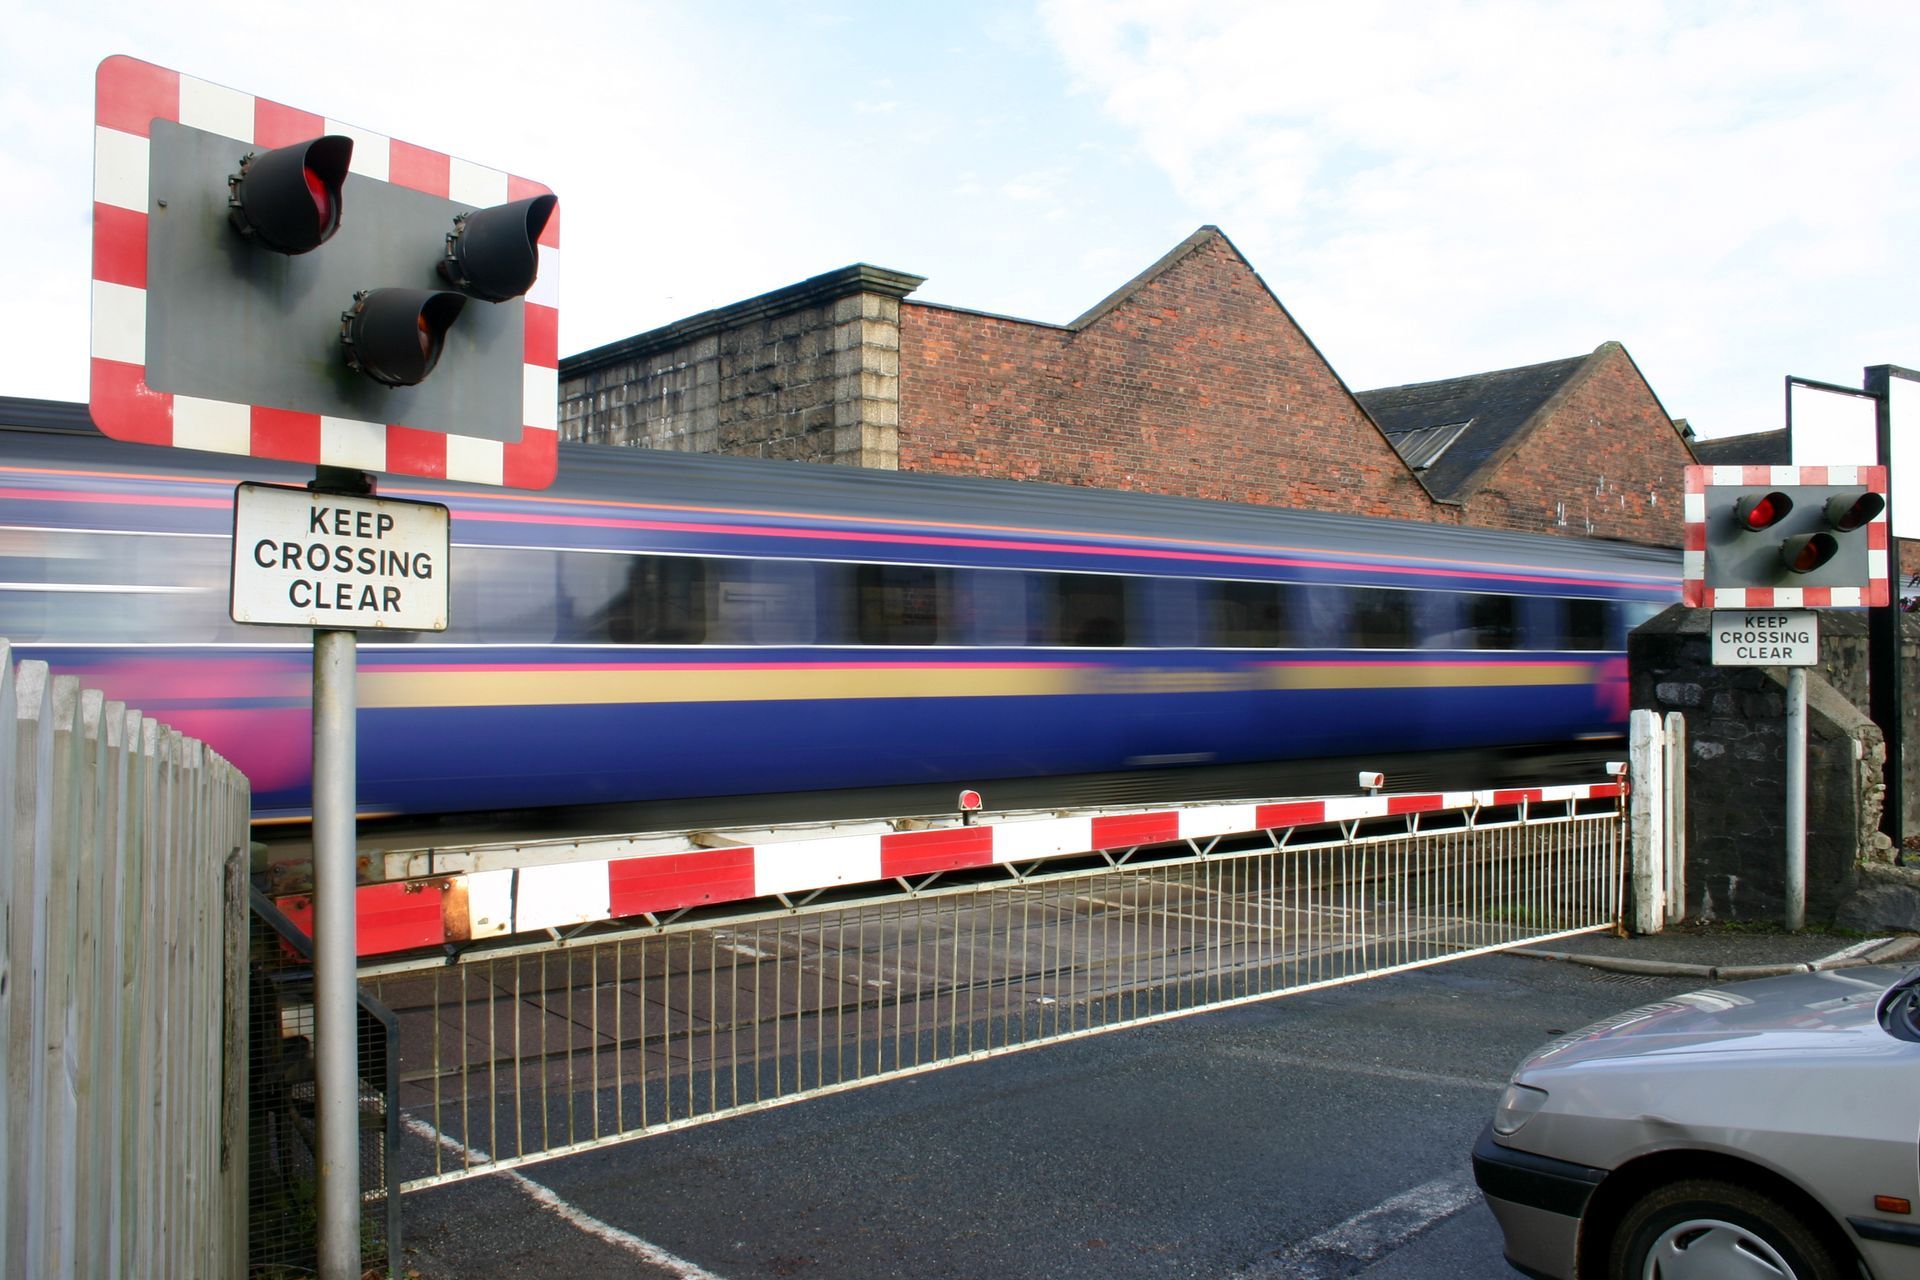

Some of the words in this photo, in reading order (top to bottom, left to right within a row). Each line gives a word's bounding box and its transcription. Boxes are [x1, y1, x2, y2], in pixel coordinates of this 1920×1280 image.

[310, 506, 394, 540] KEEP
[254, 539, 433, 579] CROSSING
[289, 579, 402, 613] CLEAR
[1745, 616, 1788, 628] KEEP
[1720, 631, 1809, 643] CROSSING
[1736, 646, 1793, 659] CLEAR
